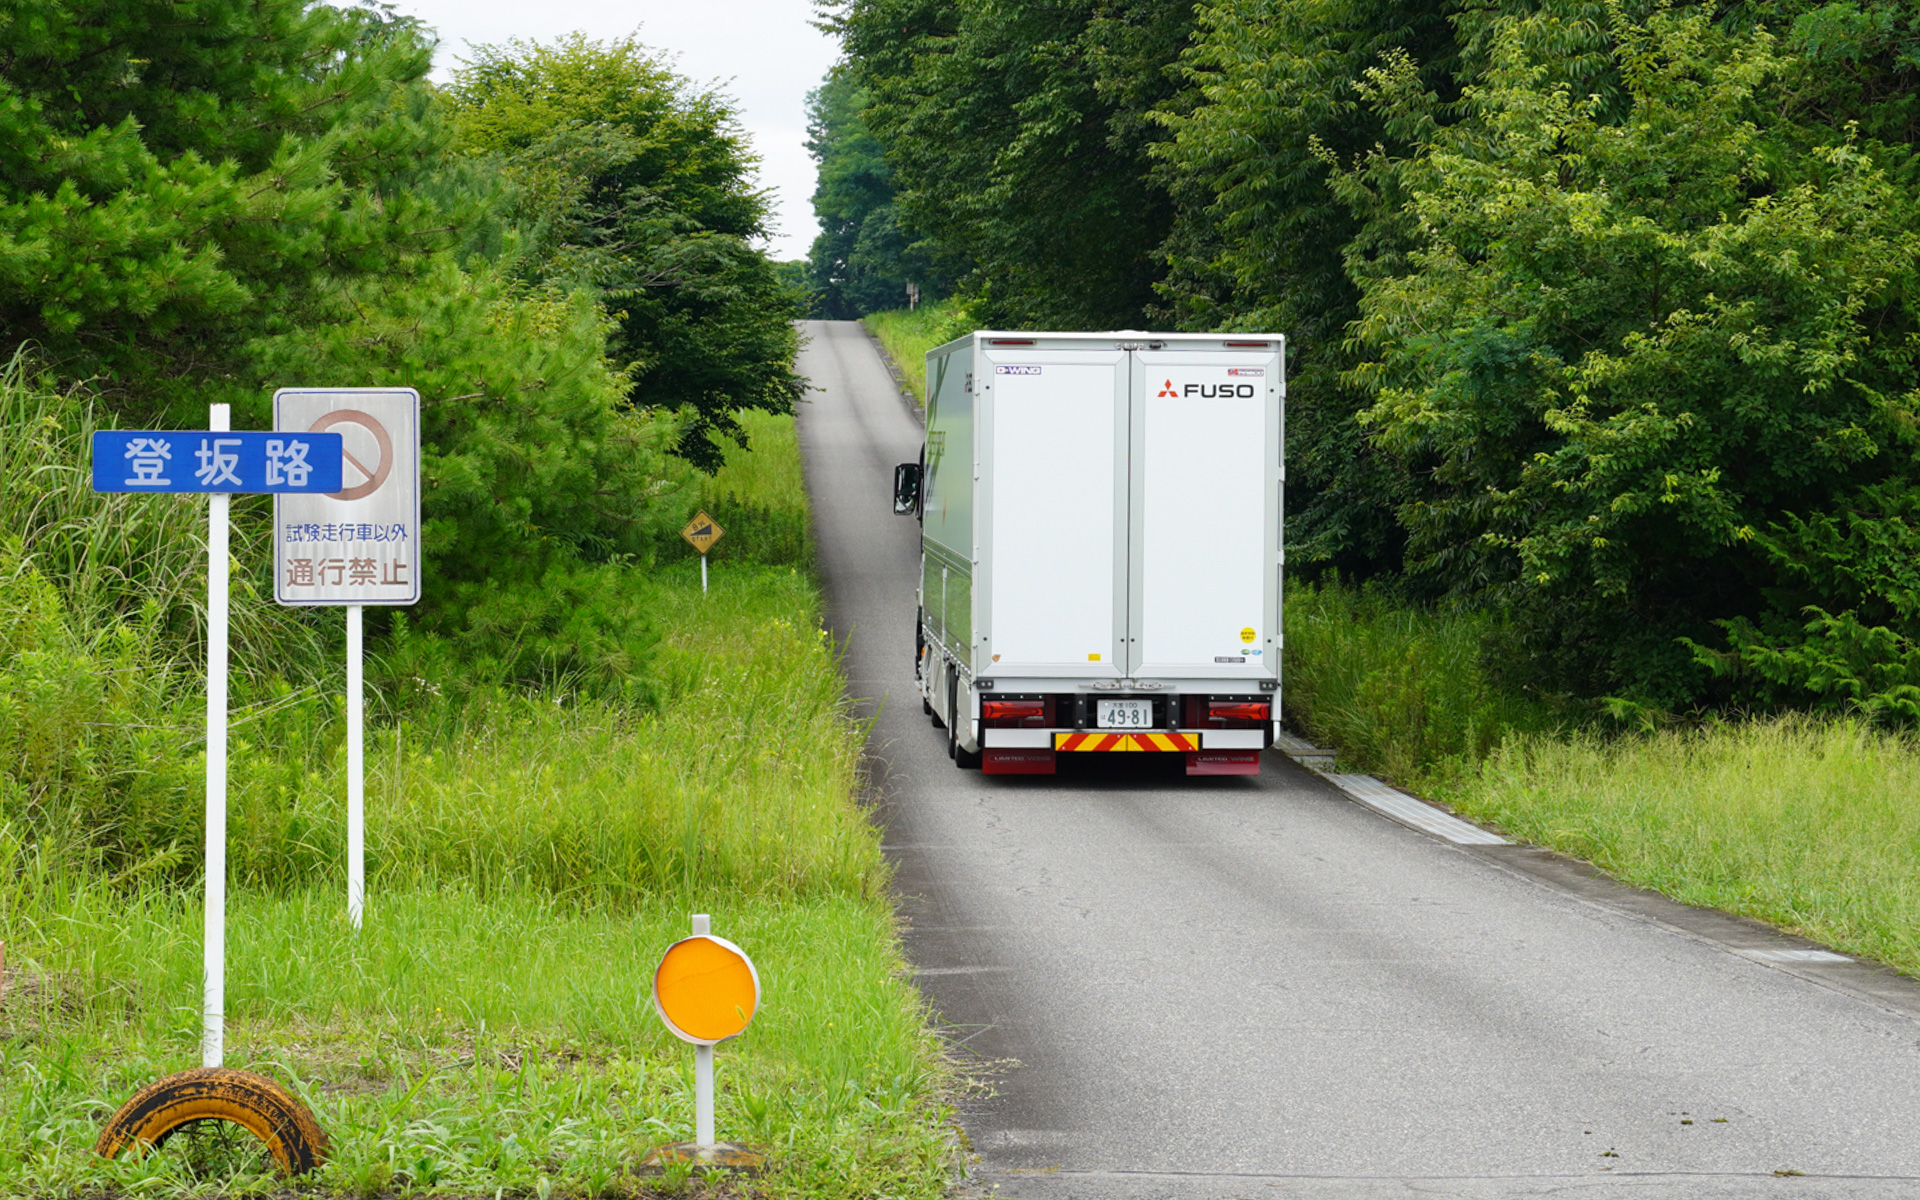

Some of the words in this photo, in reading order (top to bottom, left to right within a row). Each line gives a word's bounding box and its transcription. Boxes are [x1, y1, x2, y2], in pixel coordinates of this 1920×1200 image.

[1184, 384, 1254, 398] FUSO
[124, 438, 313, 487] 登坂路
[286, 523, 408, 543] 試験走行車以外
[286, 557, 409, 587] 通行禁止
[1107, 709, 1147, 725] 49-81
